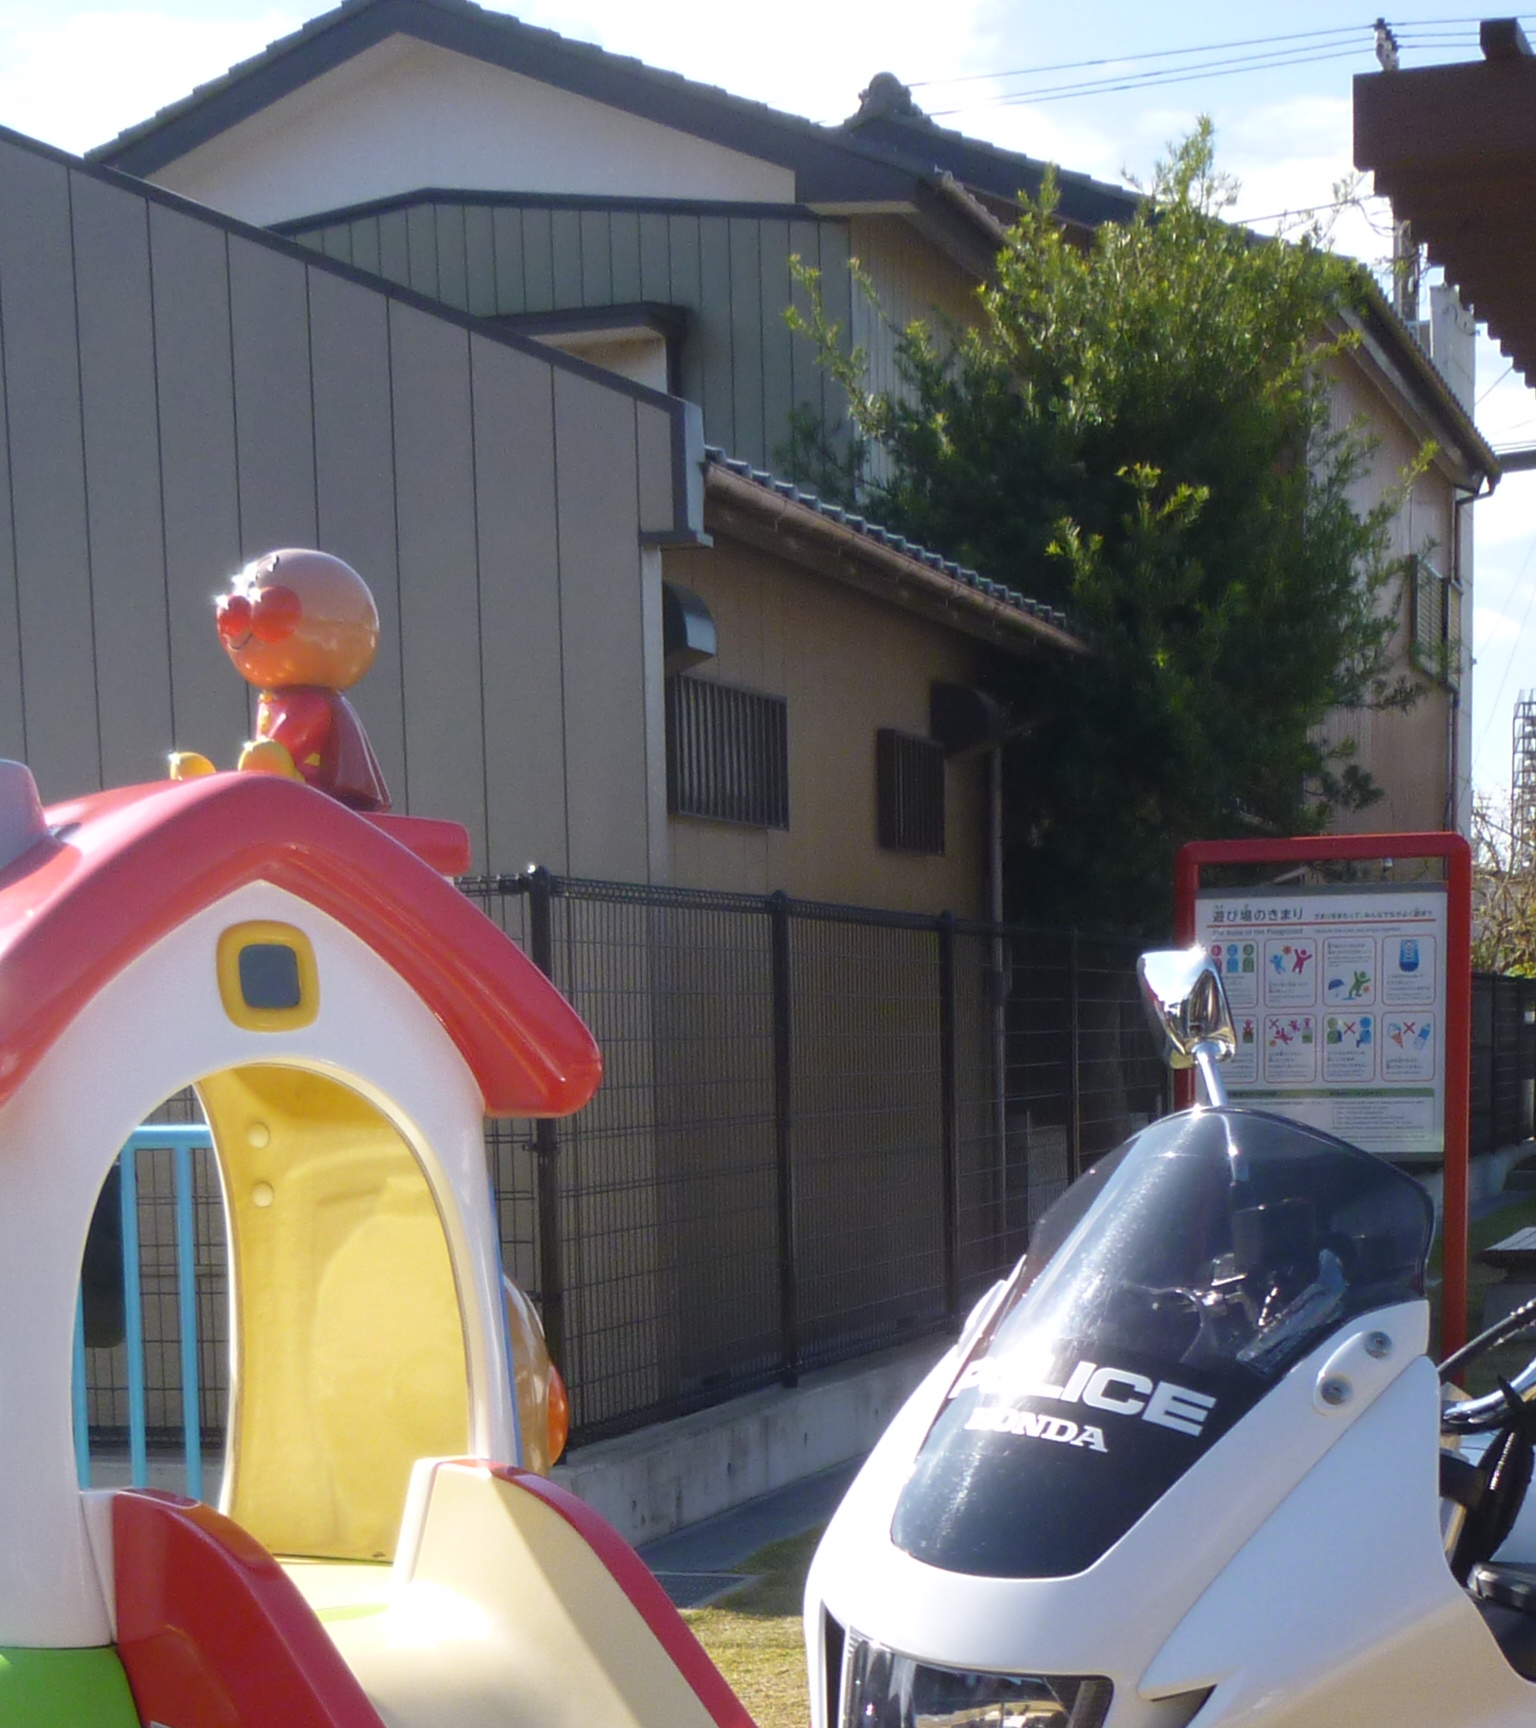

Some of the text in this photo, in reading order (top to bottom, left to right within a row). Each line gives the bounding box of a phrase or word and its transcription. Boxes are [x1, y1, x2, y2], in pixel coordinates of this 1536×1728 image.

[1212, 907, 1303, 922] 遊び場のきまり
[947, 1356, 1217, 1437] PLICE
[964, 1407, 1108, 1453] HONDA
